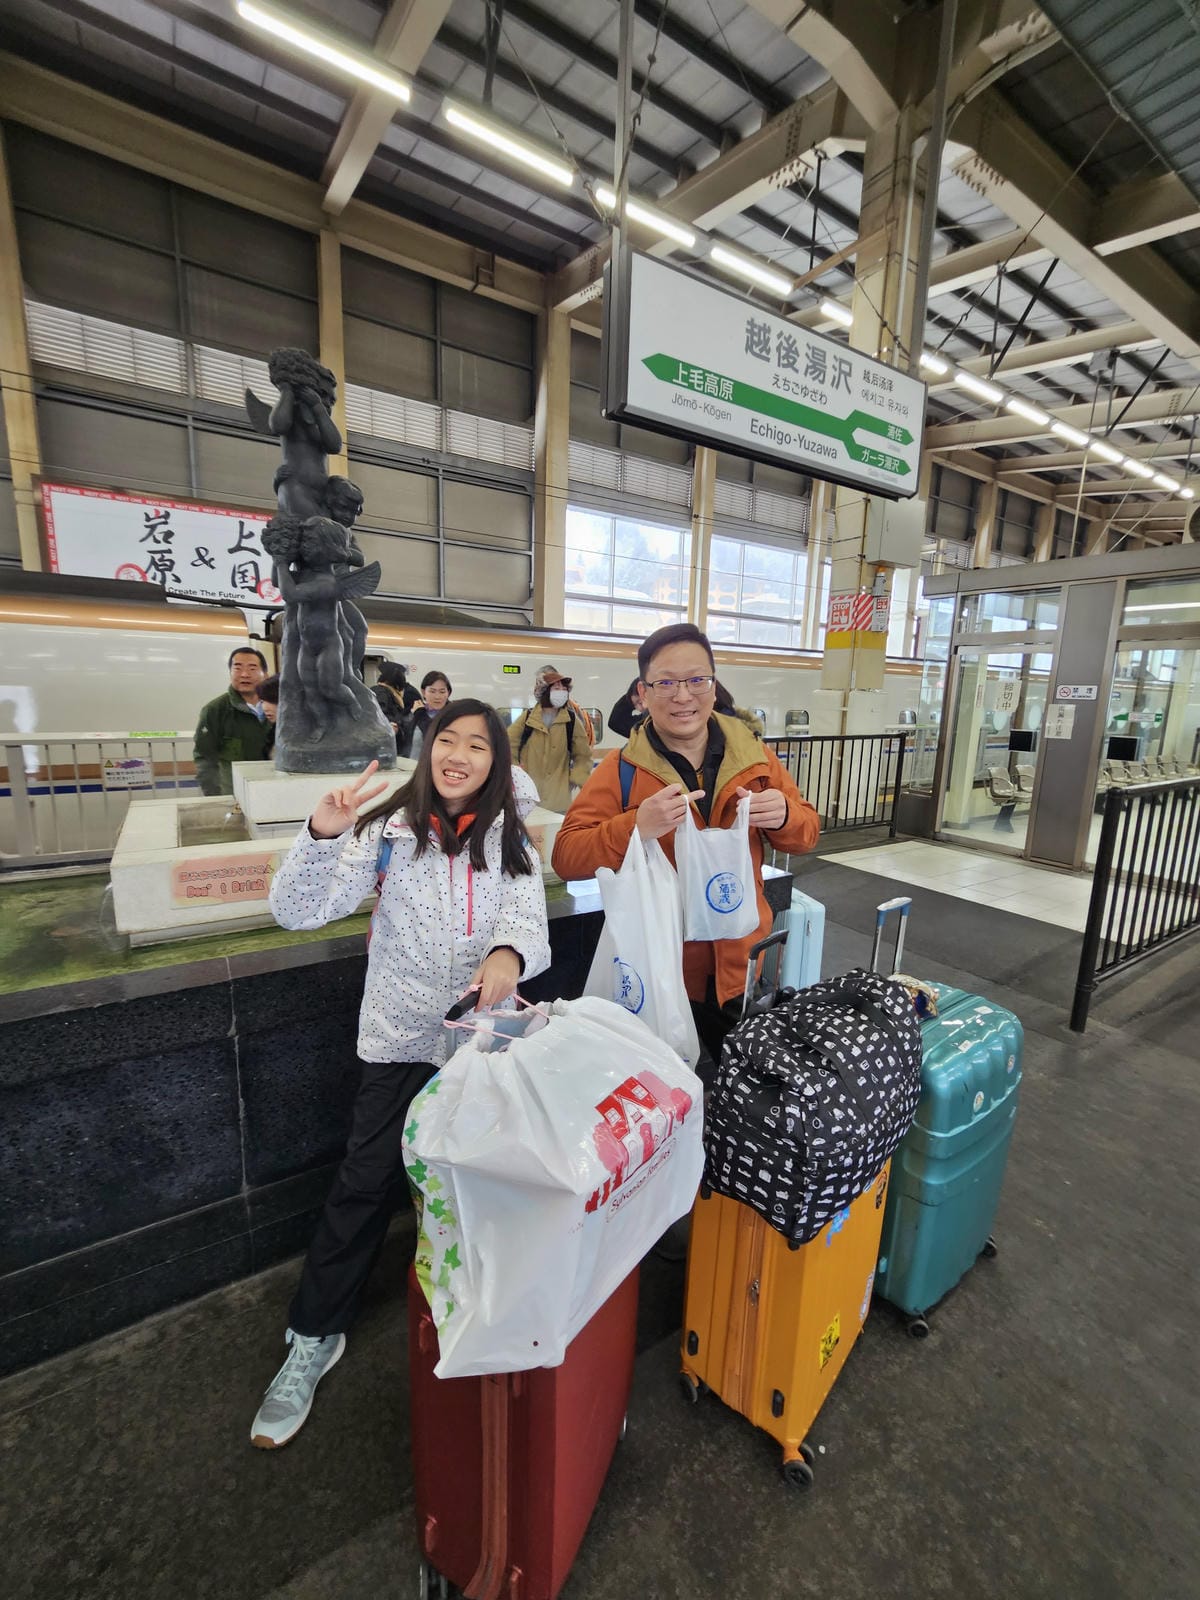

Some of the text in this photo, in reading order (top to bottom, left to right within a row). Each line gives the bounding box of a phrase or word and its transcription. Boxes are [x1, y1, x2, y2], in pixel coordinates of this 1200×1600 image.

[745, 317, 853, 395] 越後湯沢
[672, 362, 734, 401] 上毛高原
[771, 373, 828, 405] えちごゆざわ
[750, 418, 838, 460] Echigo-Yuzawa
[139, 509, 182, 585] 岩原
[190, 546, 216, 569] &
[228, 520, 261, 593] 上国
[168, 586, 246, 600] Create The Future
[833, 602, 850, 611] STOP
[232, 879, 265, 893] Drink
